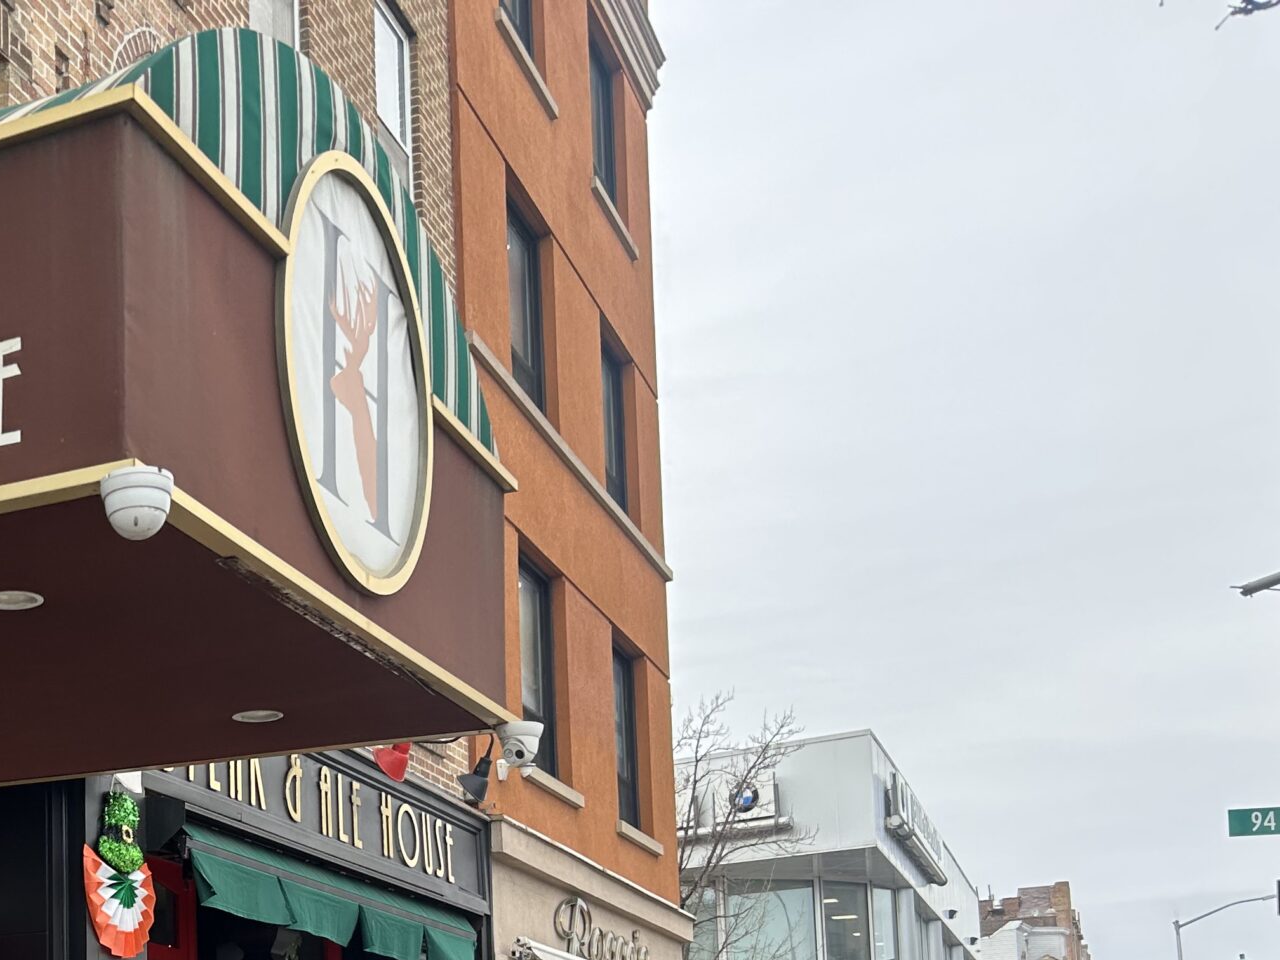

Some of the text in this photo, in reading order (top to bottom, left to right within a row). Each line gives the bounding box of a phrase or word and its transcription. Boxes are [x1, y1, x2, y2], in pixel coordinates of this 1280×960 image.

[319, 765, 363, 849] ALE
[380, 791, 455, 884] HOUSE
[1251, 811, 1276, 831] 94
